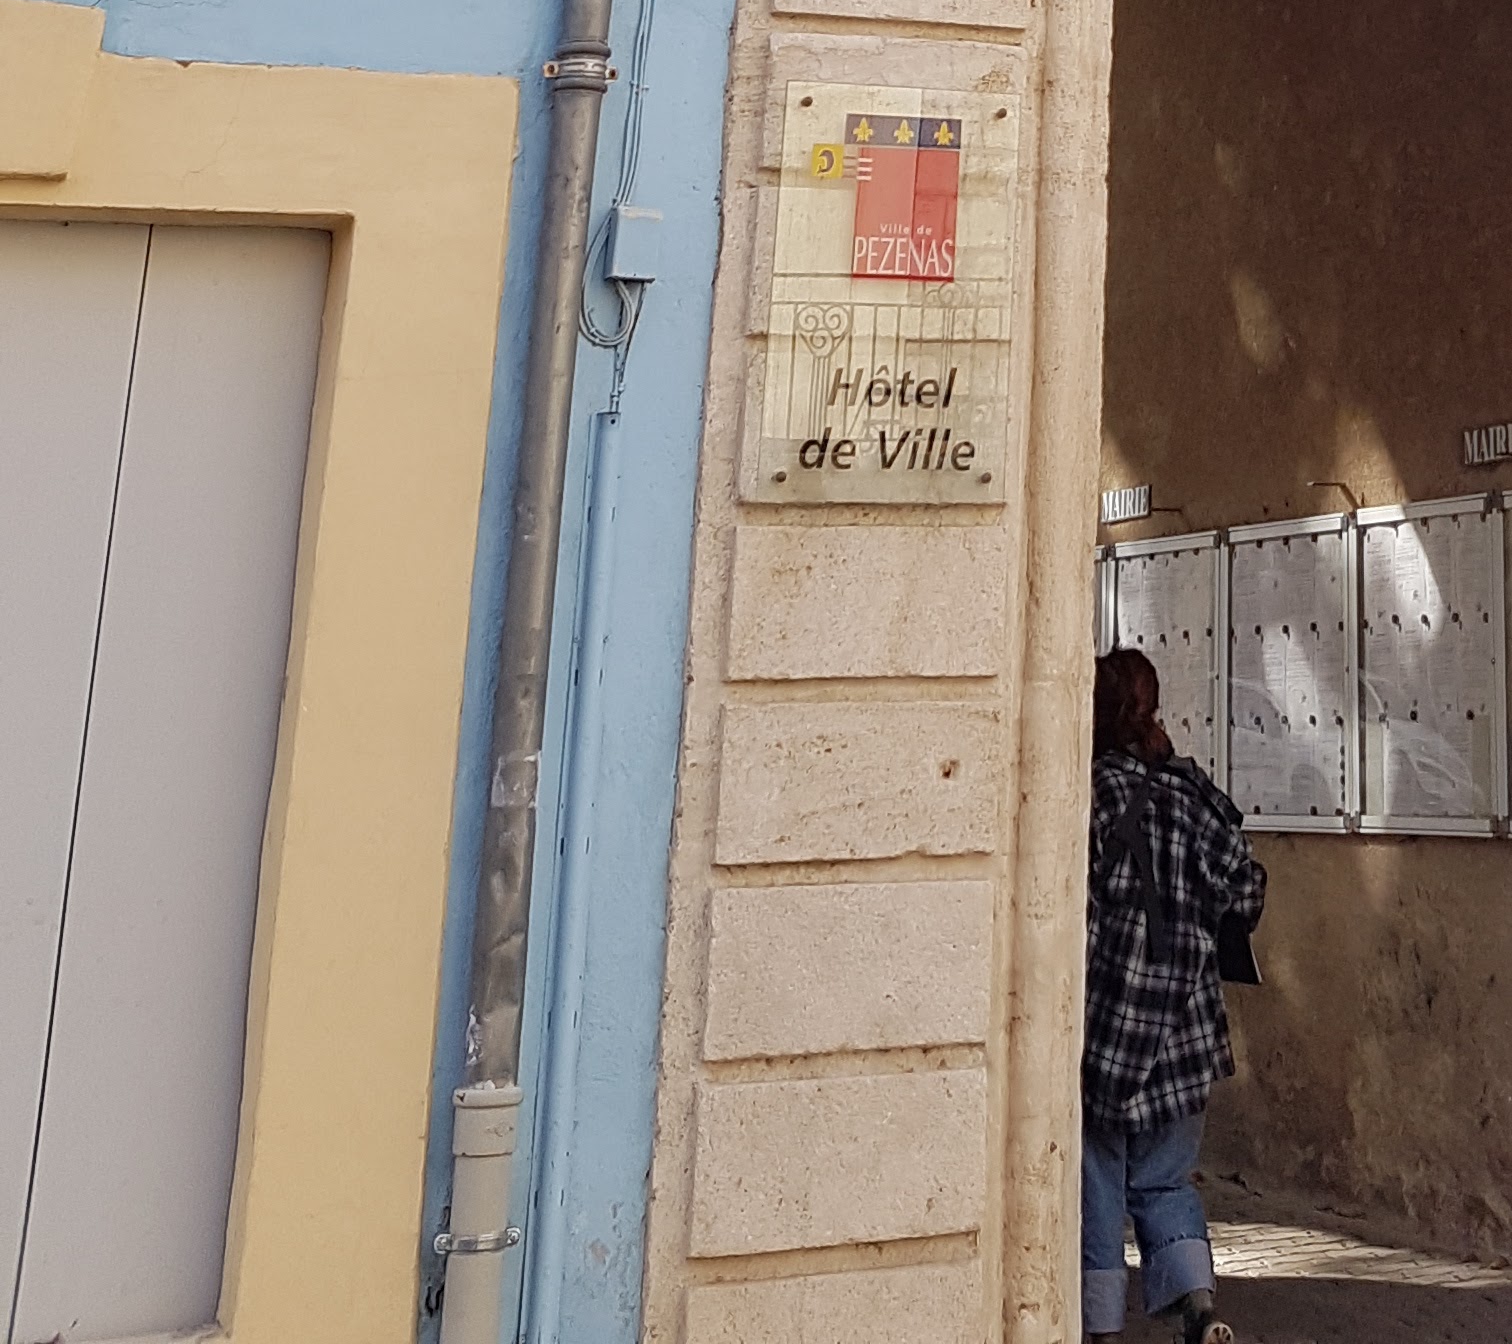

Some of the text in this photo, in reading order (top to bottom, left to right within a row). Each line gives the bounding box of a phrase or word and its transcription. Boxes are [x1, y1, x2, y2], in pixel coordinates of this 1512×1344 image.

[916, 224, 933, 236] de
[852, 235, 954, 277] PEZENAS
[827, 365, 959, 409] Hôtel
[800, 426, 976, 472] de Ville
[1101, 486, 1149, 523] MAIRIE
